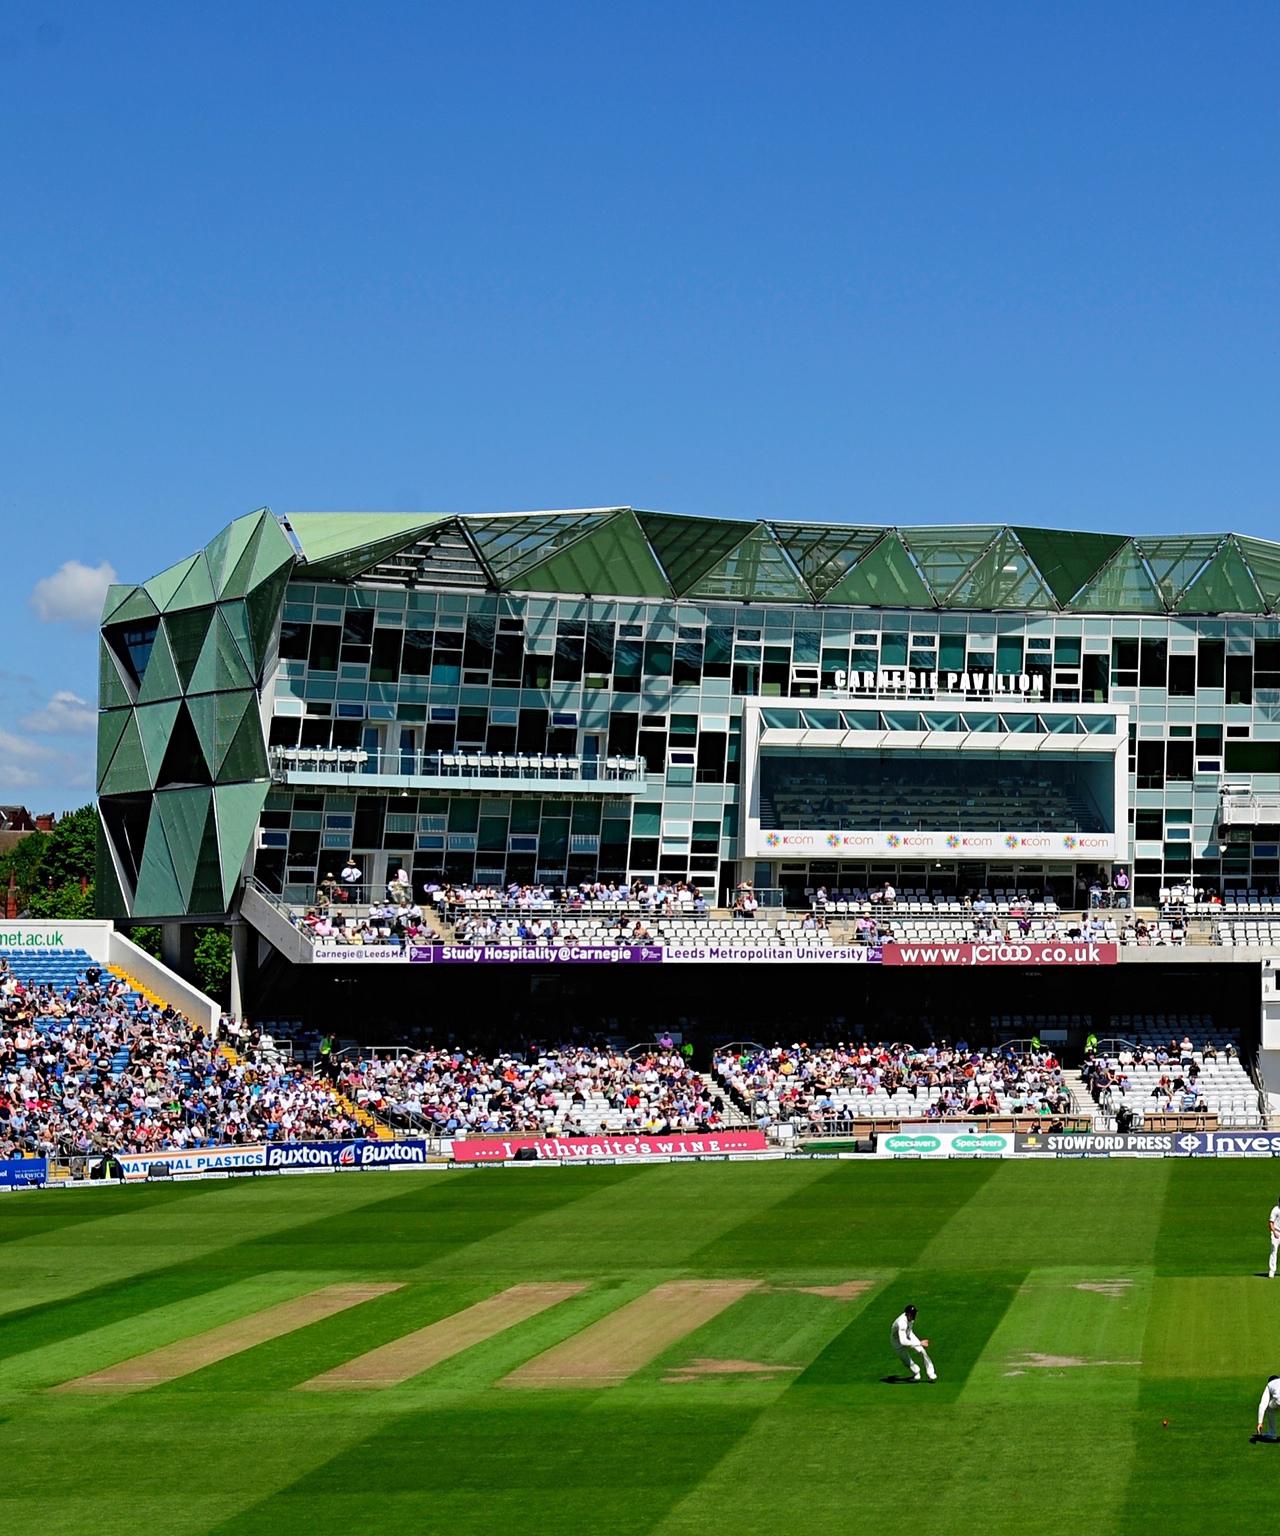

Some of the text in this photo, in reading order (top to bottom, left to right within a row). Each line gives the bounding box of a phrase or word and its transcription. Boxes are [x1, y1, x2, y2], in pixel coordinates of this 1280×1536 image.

[834, 669, 1044, 691] CARNEGIE PAVILION
[315, 949, 391, 960] Carnegie@Leeds
[442, 948, 480, 962] Study
[484, 948, 632, 962] Hospitality@Carnegie
[666, 948, 705, 959] Leeds
[709, 948, 792, 961] Metropolitan
[796, 948, 863, 961] University
[502, 1137, 652, 1158] Lithwaite's
[890, 1139, 936, 1149] Specsavers
[956, 1139, 1003, 1149] Specsavers
[1048, 1136, 1124, 1150] STOWFORD
[1128, 1136, 1172, 1150] PRESS
[197, 1154, 263, 1168] PLASTICS
[269, 1143, 423, 1166] Buxton Buxton
